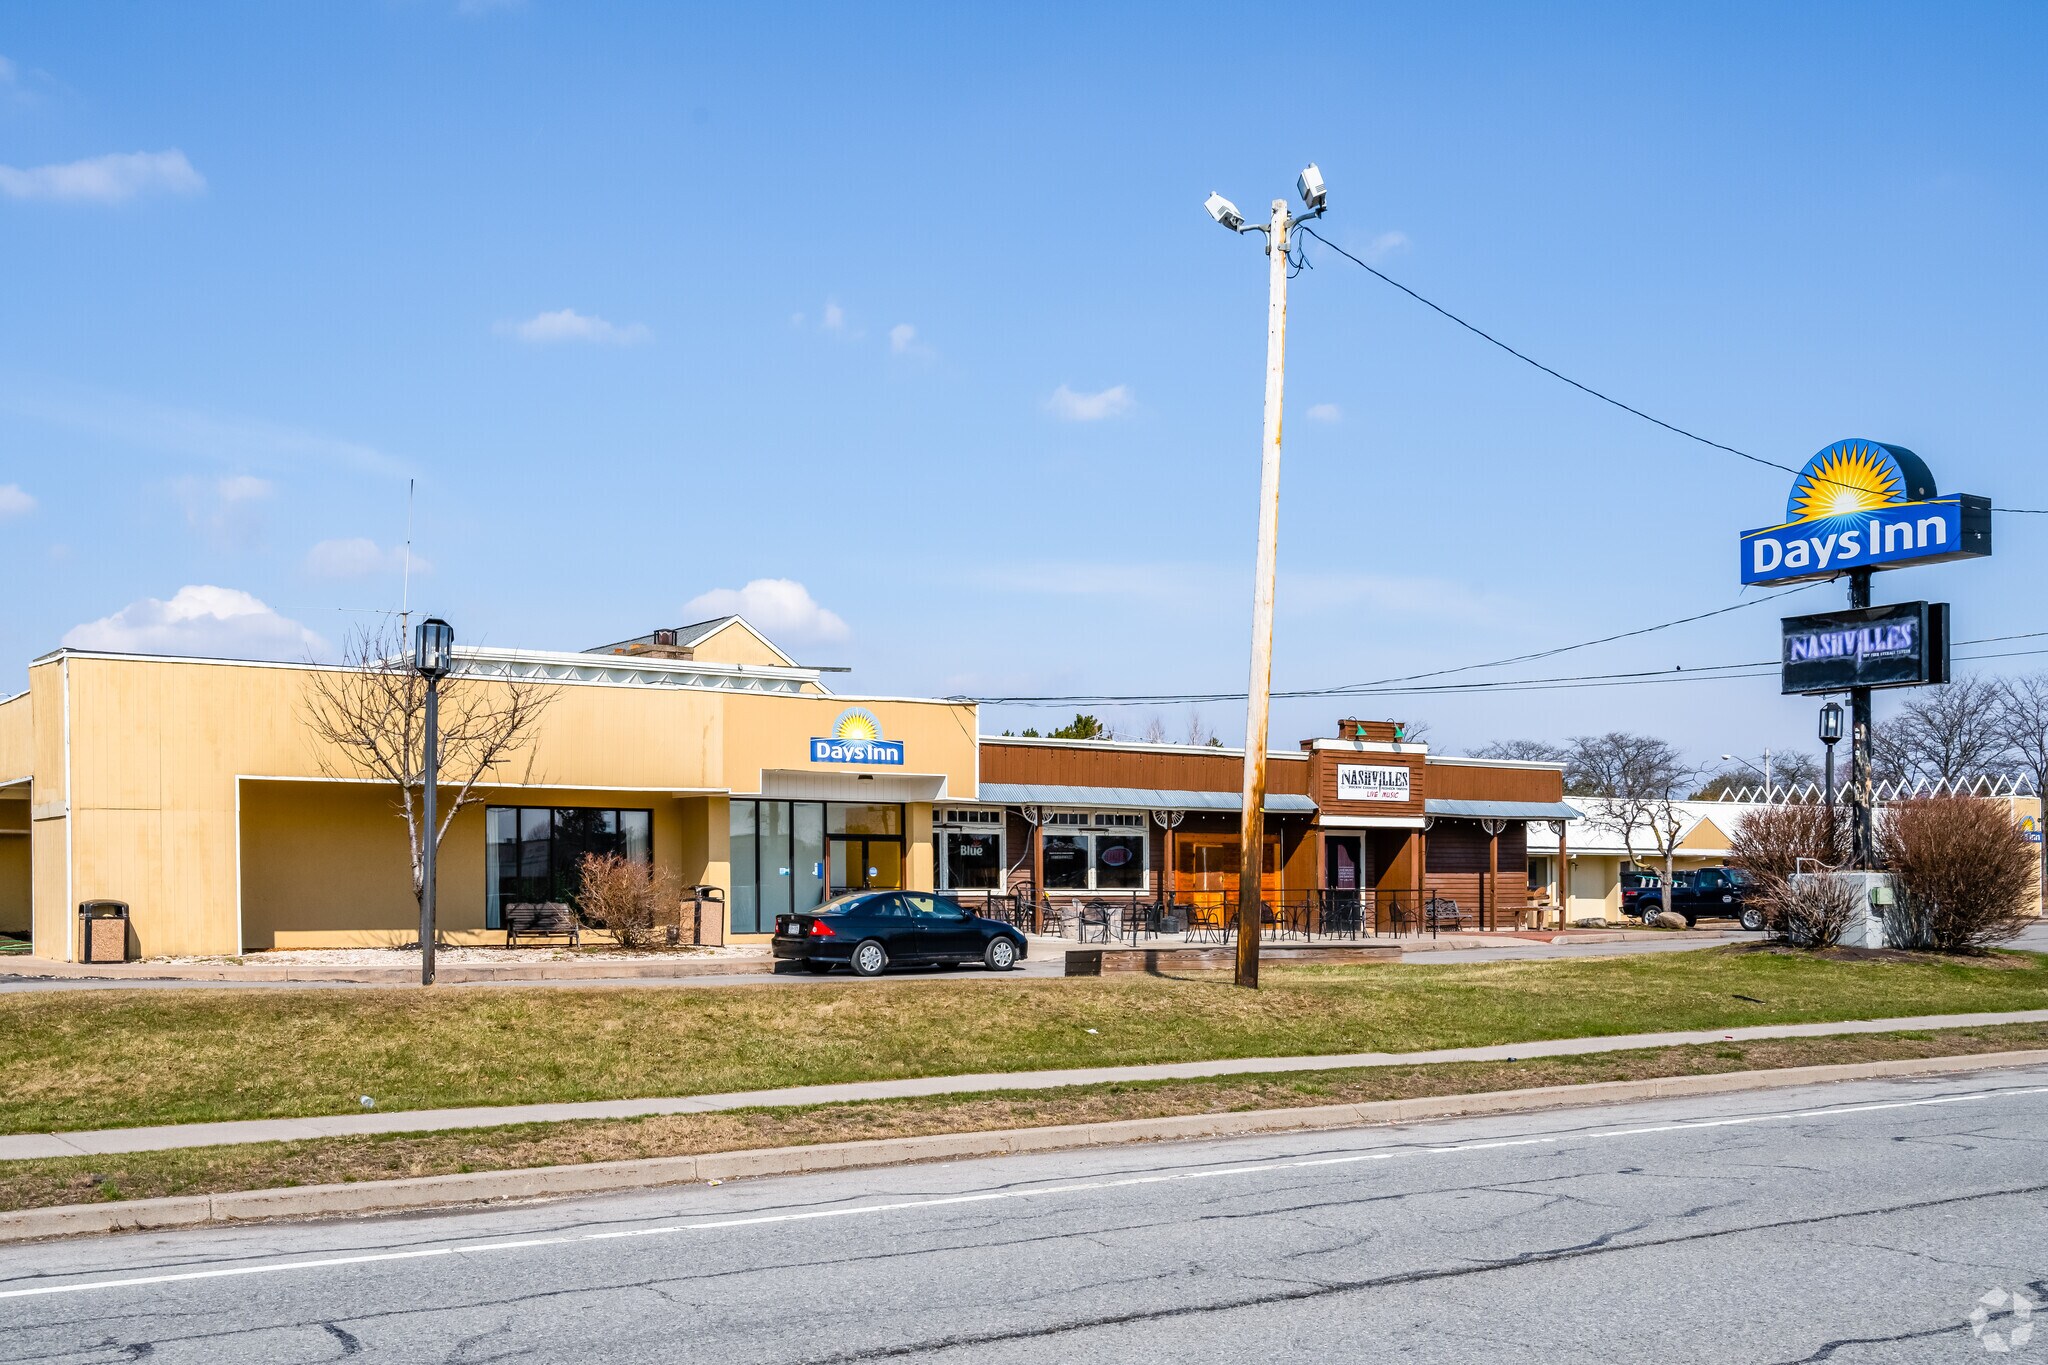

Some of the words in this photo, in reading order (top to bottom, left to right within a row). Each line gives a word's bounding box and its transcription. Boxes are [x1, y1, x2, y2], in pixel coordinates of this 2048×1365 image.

[1754, 530, 1861, 574] Days
[1869, 516, 1947, 555] Inn
[1791, 624, 1912, 662] NASHVILLES
[816, 742, 864, 762] Days
[867, 745, 899, 761] Inn
[1341, 770, 1408, 787] NASHVILLES
[1381, 791, 1399, 799] MUSIC
[960, 844, 983, 856] Blue
